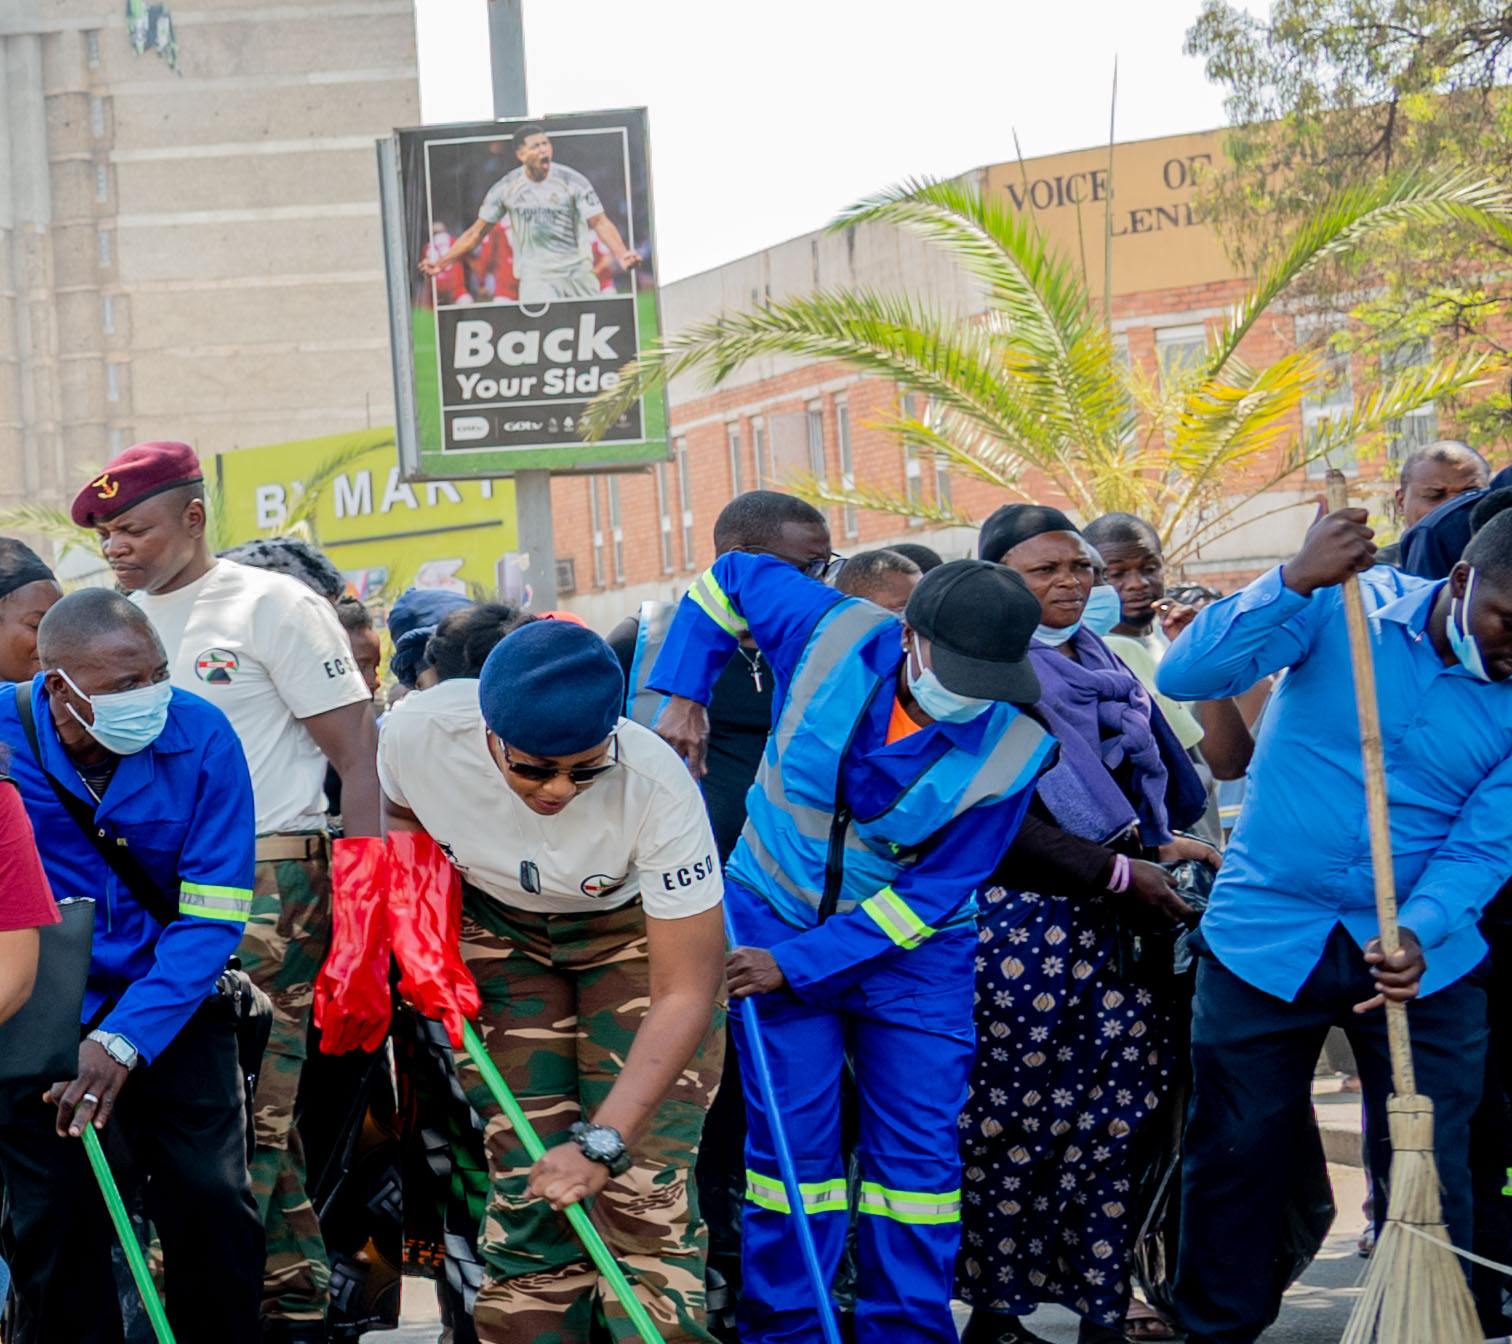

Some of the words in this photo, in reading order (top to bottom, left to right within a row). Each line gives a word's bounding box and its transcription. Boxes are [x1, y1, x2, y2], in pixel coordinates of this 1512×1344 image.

[1007, 170, 1112, 211] VOICE
[1163, 154, 1212, 190] OF
[454, 313, 620, 369] Back
[456, 372, 537, 400] Your
[542, 366, 621, 395] Side
[662, 854, 714, 892] ECSD
